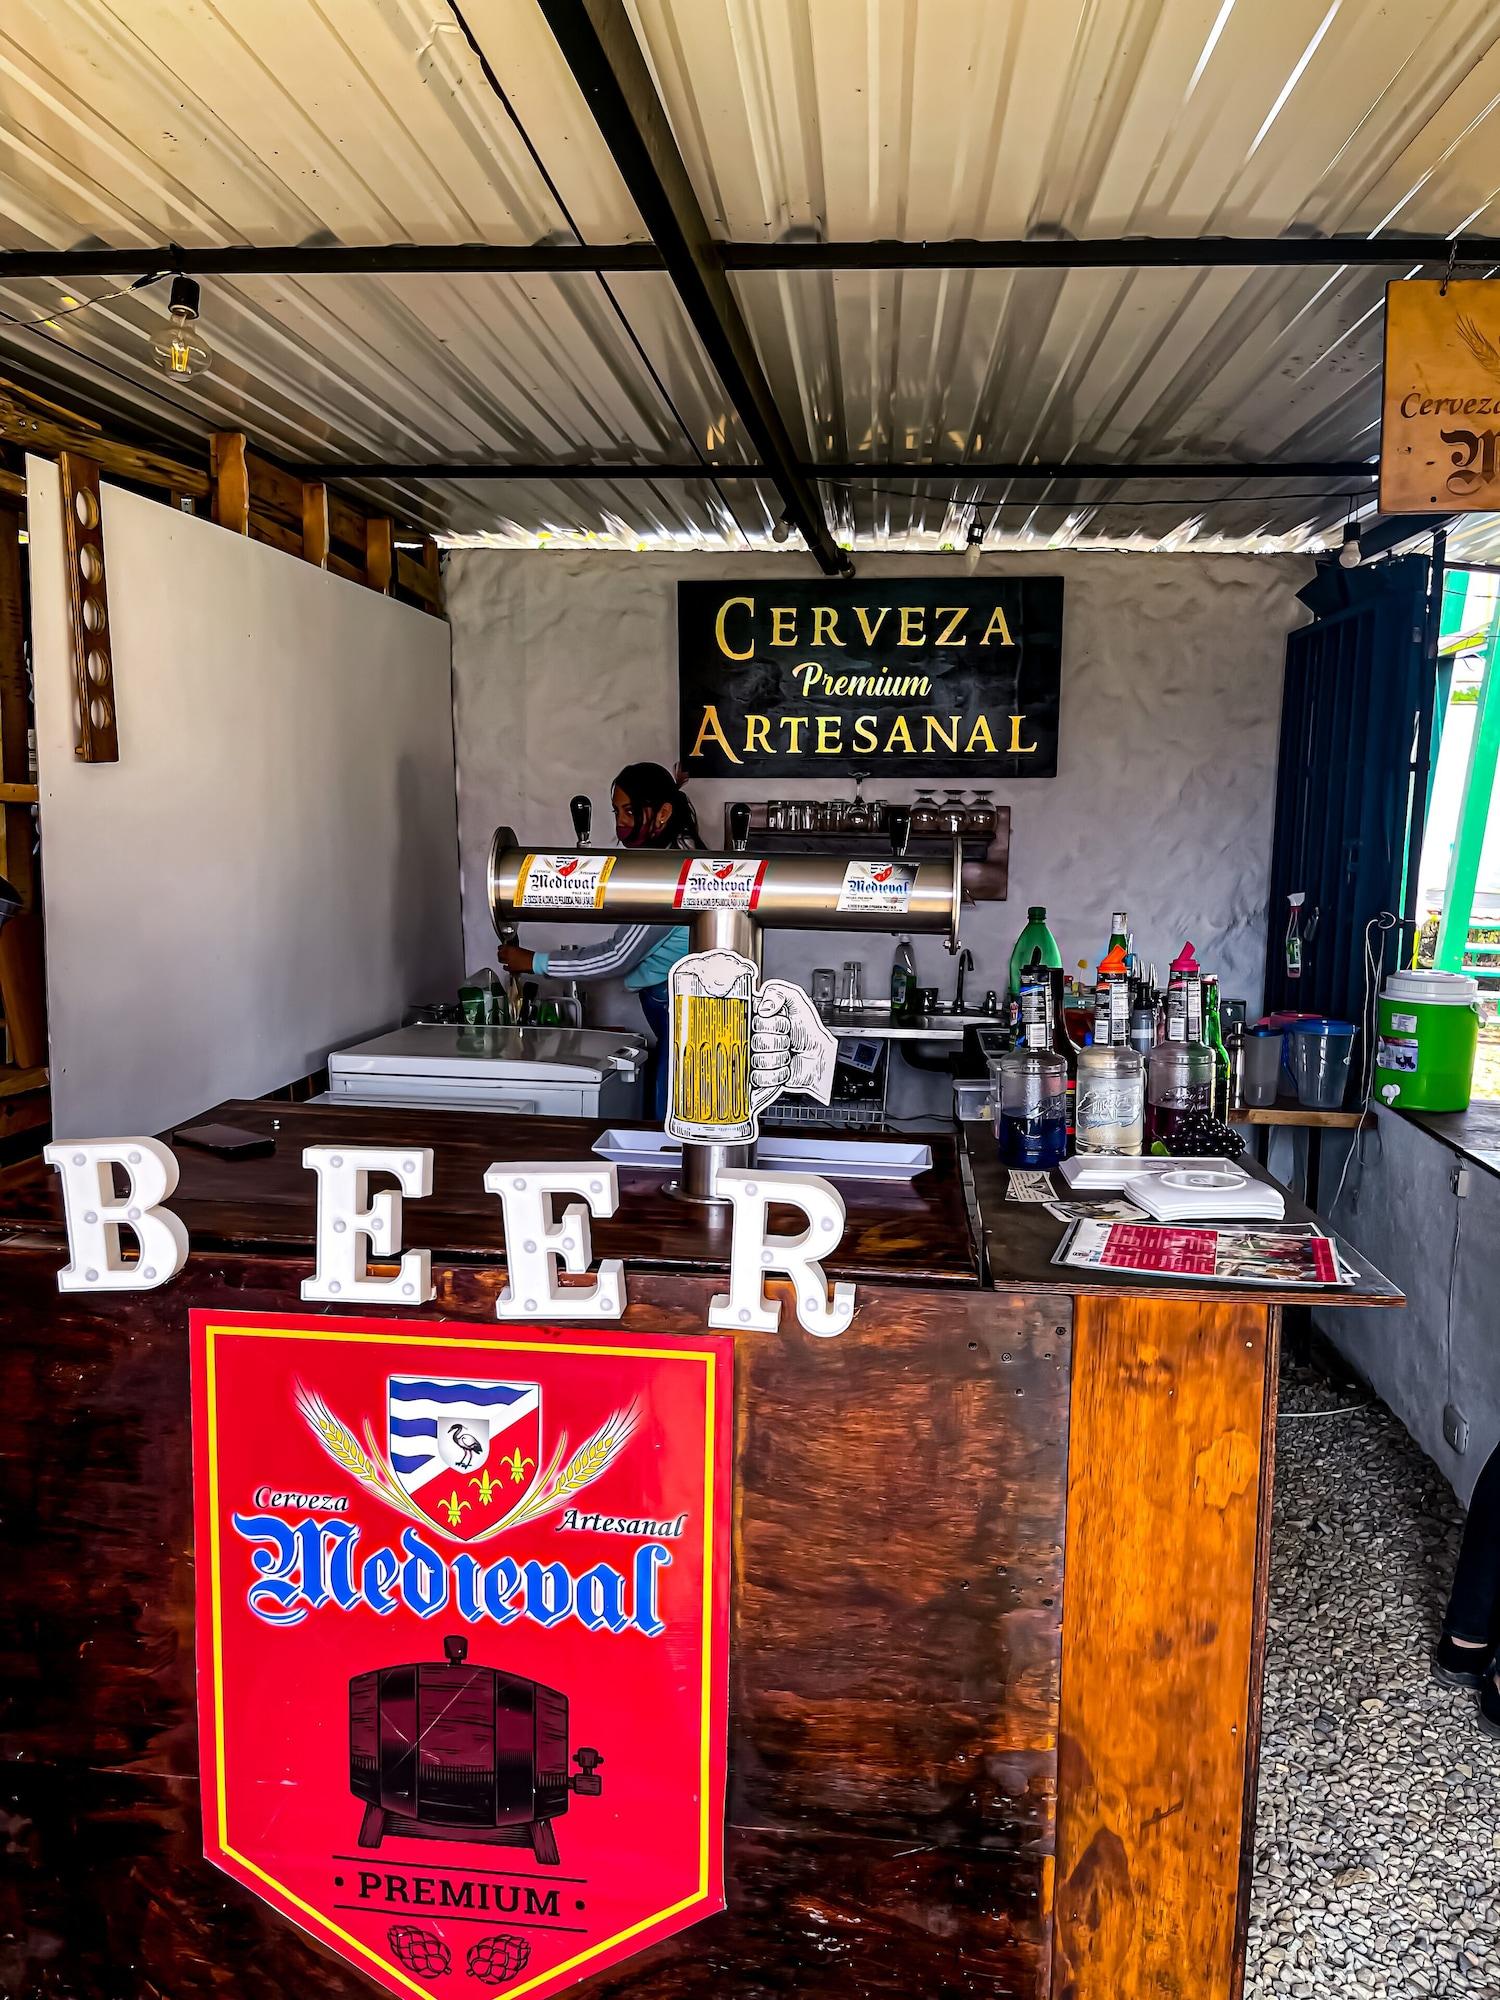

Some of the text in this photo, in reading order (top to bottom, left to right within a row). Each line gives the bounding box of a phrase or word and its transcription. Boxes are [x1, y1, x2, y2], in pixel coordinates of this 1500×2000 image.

[714, 596, 1015, 661] CERVEZA
[791, 661, 932, 698] Premium
[689, 705, 1037, 765] ARTESANAL
[529, 874, 597, 891] Medieval
[688, 877, 752, 894] Medieval
[847, 879, 909, 896] Medieval
[43, 1135, 857, 1338] BEER
[255, 1486, 689, 1537] Cerveza Artesanal
[233, 1511, 673, 1636] Medieval
[358, 1871, 561, 1917] PREMIUM
